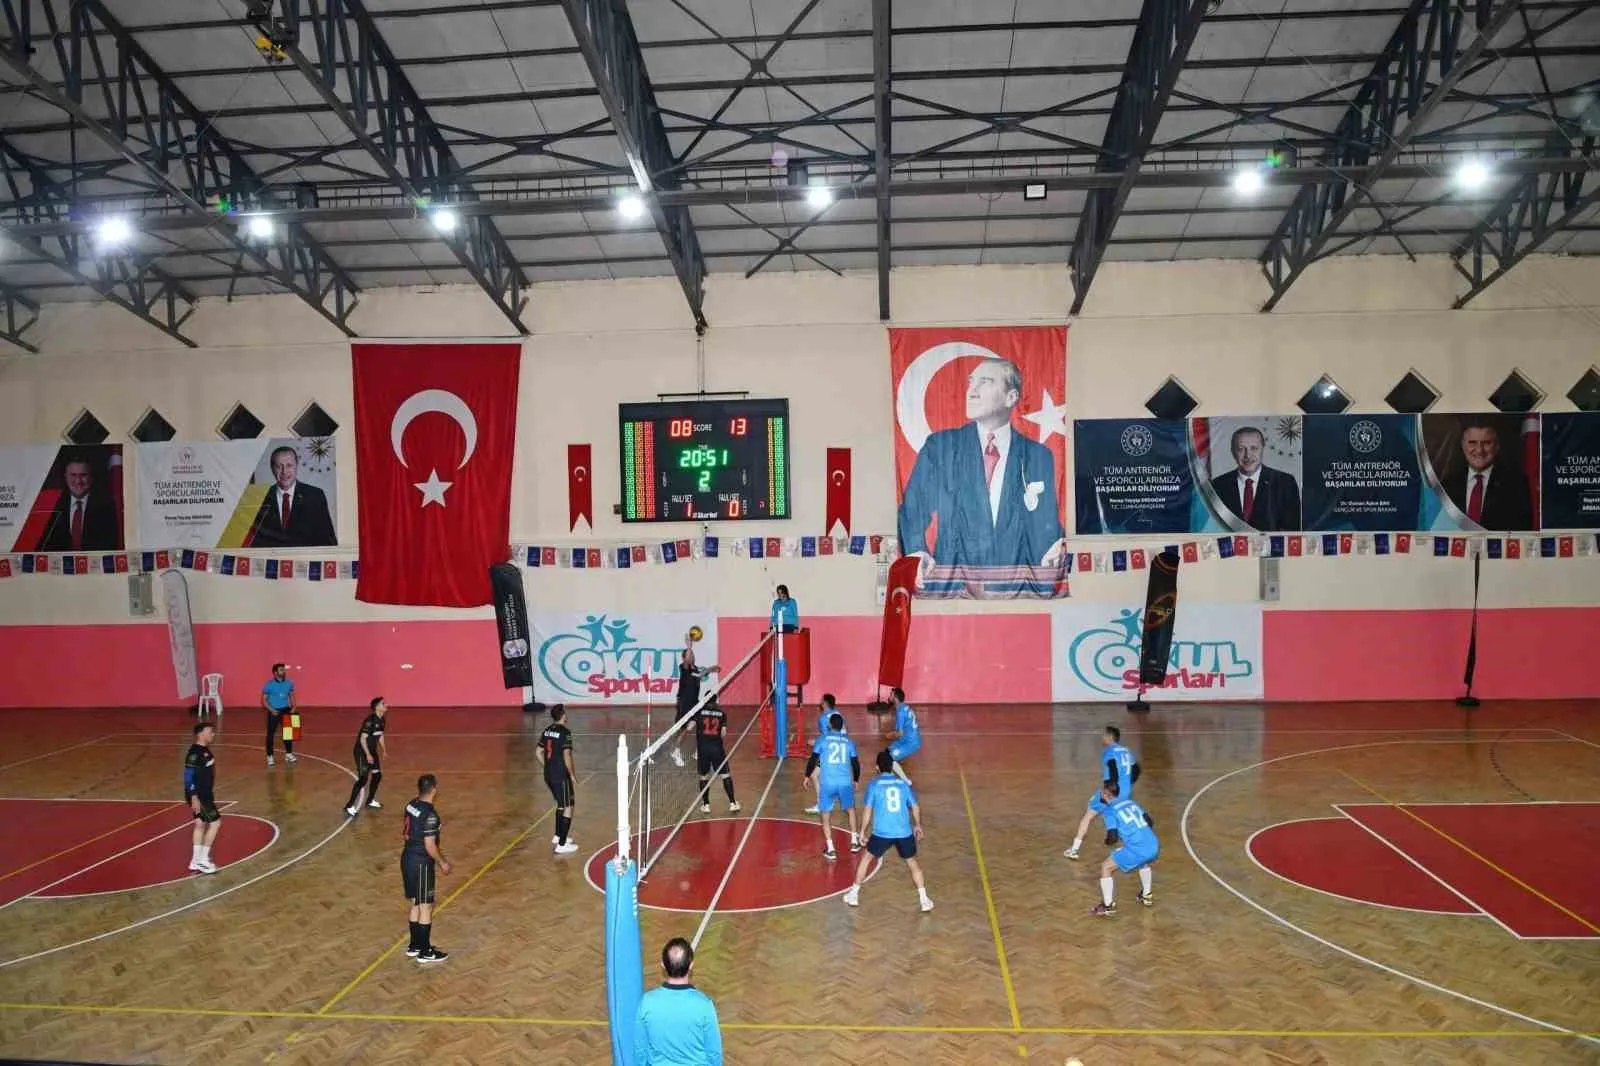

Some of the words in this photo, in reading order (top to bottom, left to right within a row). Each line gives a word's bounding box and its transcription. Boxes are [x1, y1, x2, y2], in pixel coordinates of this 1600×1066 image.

[671, 420, 692, 437] 08
[693, 423, 713, 432] SCORE
[731, 418, 746, 435] 13
[680, 449, 728, 467] 20:51
[1331, 461, 1352, 470] TÜM
[1353, 460, 1401, 470] ANTRENÖR
[1103, 465, 1123, 475] TÜM
[1124, 465, 1172, 474] ANTRENÖR
[1322, 471, 1334, 479] VE
[699, 470, 710, 488] 2
[1094, 477, 1105, 485] VE
[1325, 480, 1366, 488] BAŞARILAR
[1095, 485, 1137, 493] BAŞARILAR
[729, 499, 740, 517] 0
[827, 743, 846, 764] 21
[885, 786, 901, 812] 8
